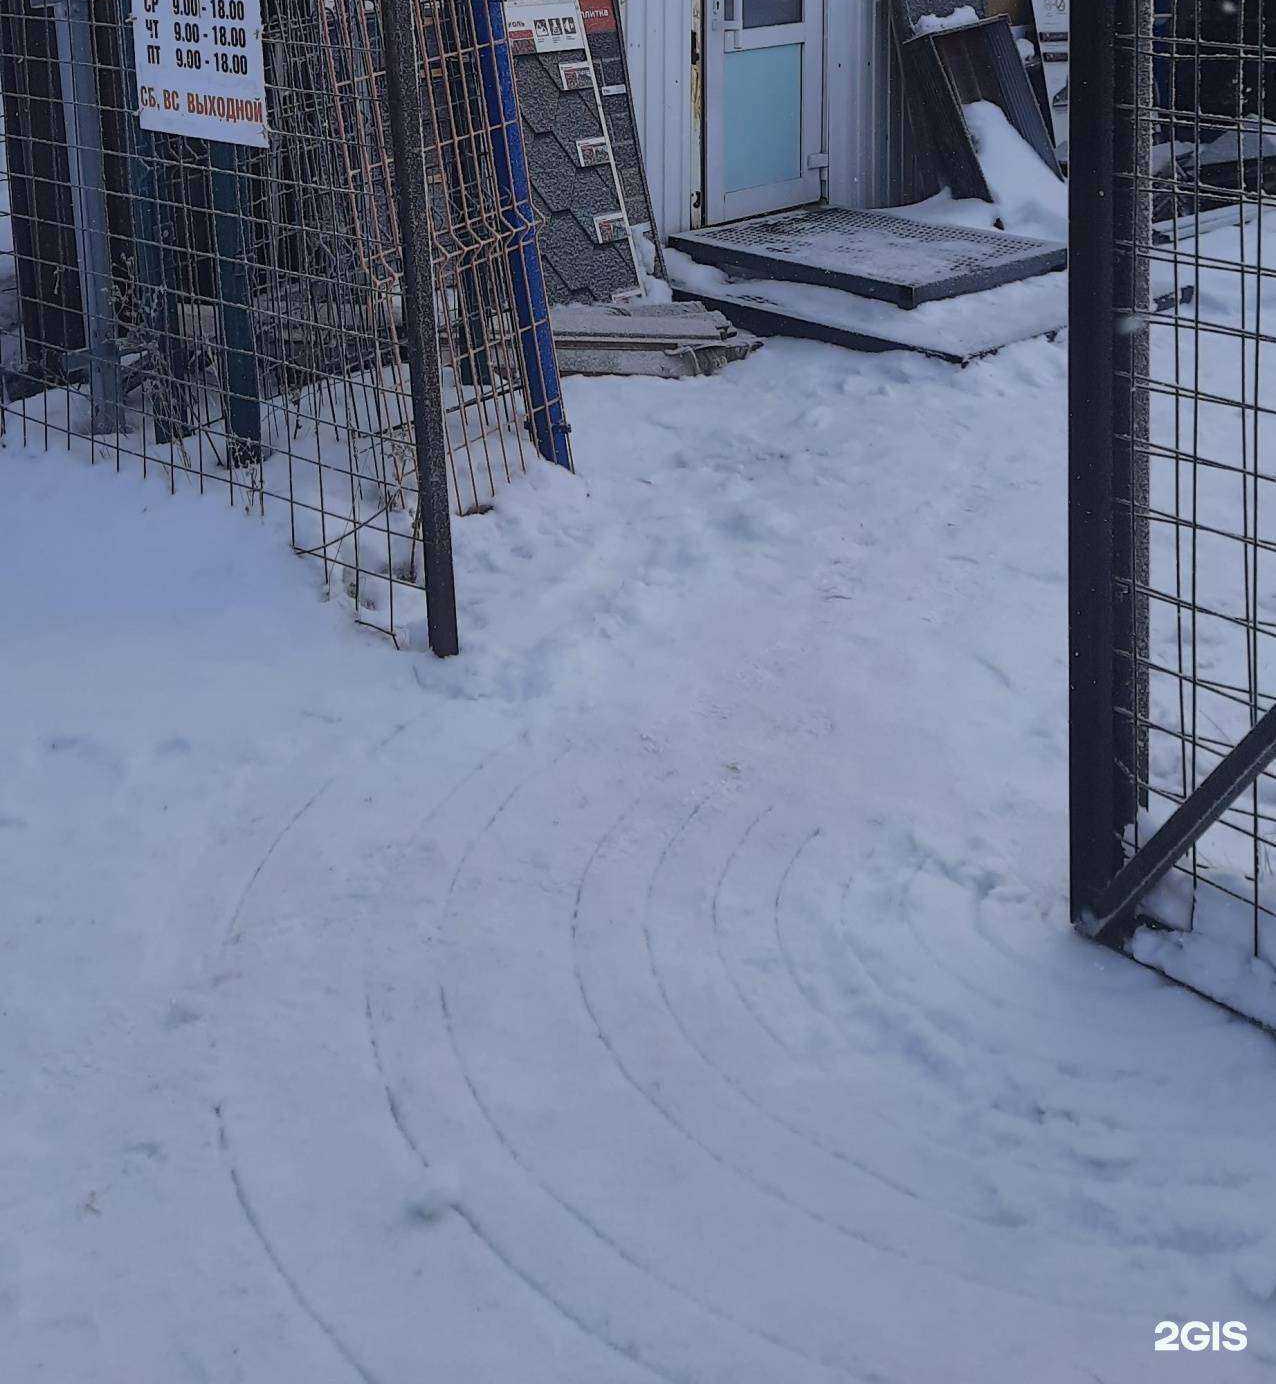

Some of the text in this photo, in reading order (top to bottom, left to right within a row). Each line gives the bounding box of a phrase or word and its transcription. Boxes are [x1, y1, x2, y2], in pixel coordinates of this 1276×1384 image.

[209, 0, 245, 21] 18.00
[145, 19, 159, 40] ЧТ
[174, 21, 200, 44] 9.00
[211, 25, 246, 48] 18.00
[147, 44, 160, 65] ПТ
[175, 47, 201, 70] 9.00
[213, 52, 248, 76] 18.00
[162, 89, 180, 112] ВС
[187, 92, 263, 124] ВЫХОДНОЙ
